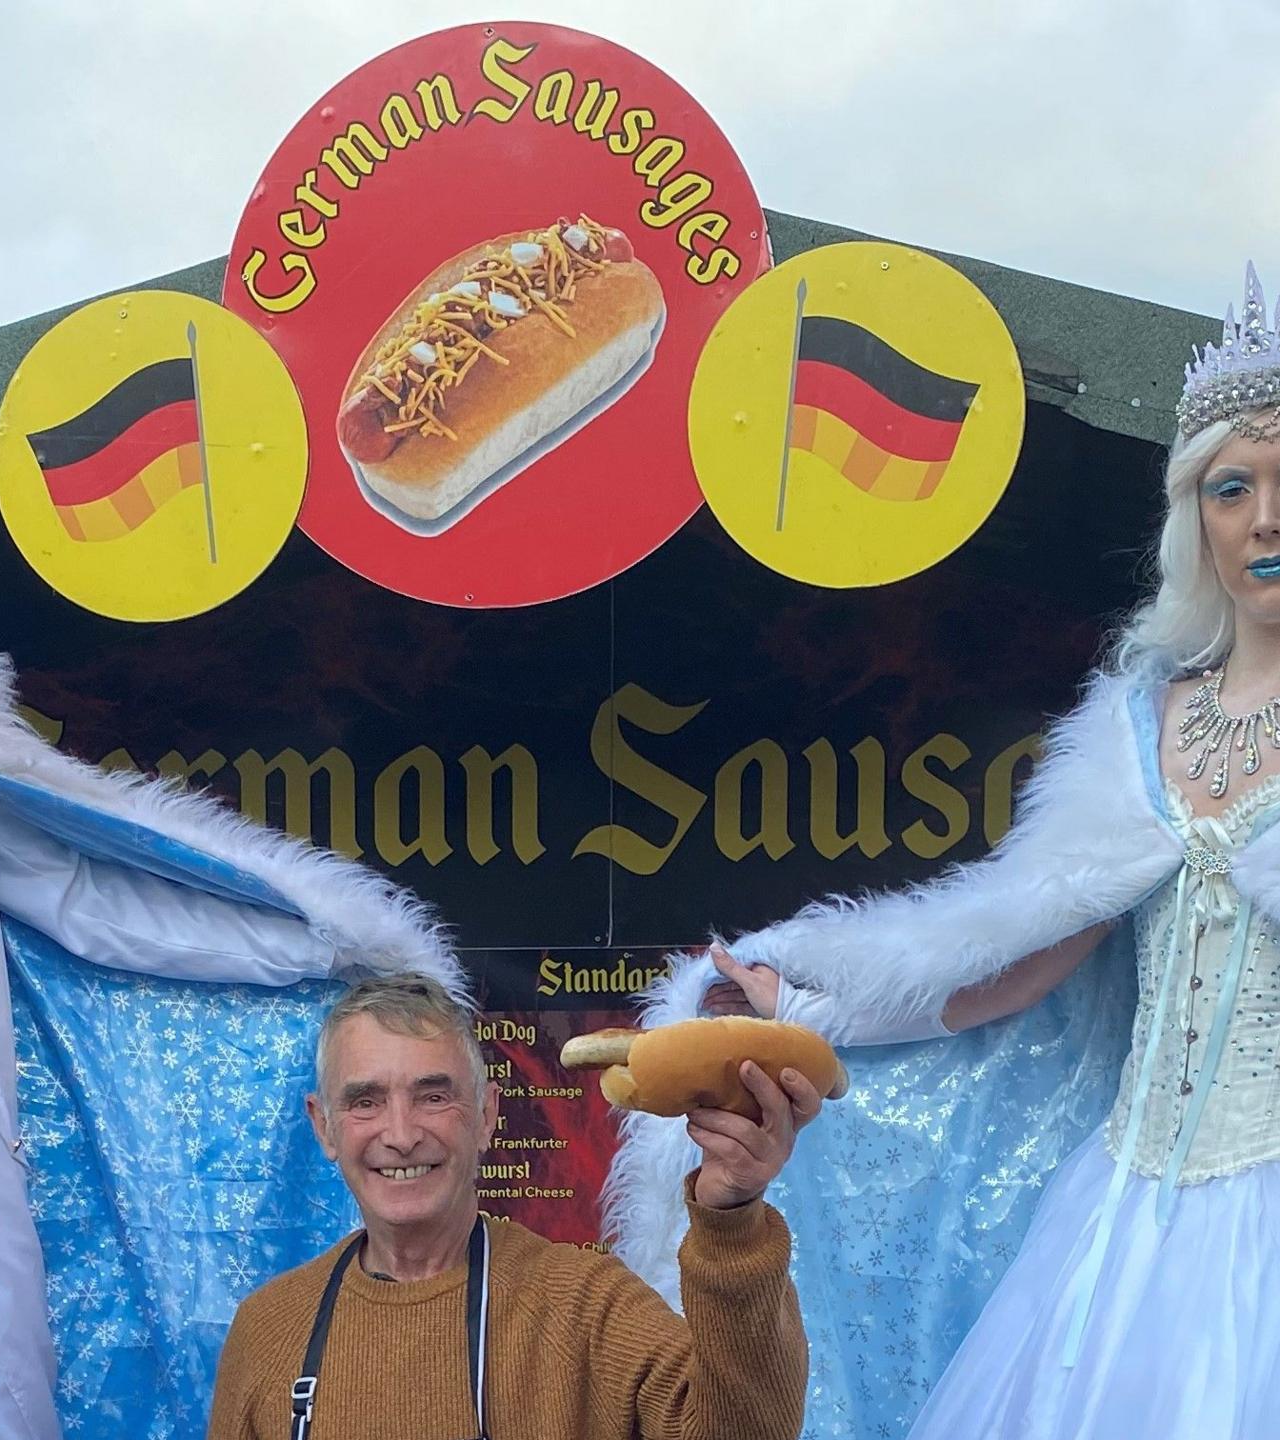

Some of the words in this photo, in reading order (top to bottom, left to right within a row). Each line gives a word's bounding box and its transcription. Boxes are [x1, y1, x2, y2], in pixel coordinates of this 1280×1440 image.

[244, 73, 464, 313] German
[465, 37, 741, 286] Sausages
[500, 1019, 536, 1046] Dog
[528, 1085, 583, 1100] Sausage
[494, 1137, 569, 1149] Frankfurter
[525, 1186, 574, 1198] Cheese
